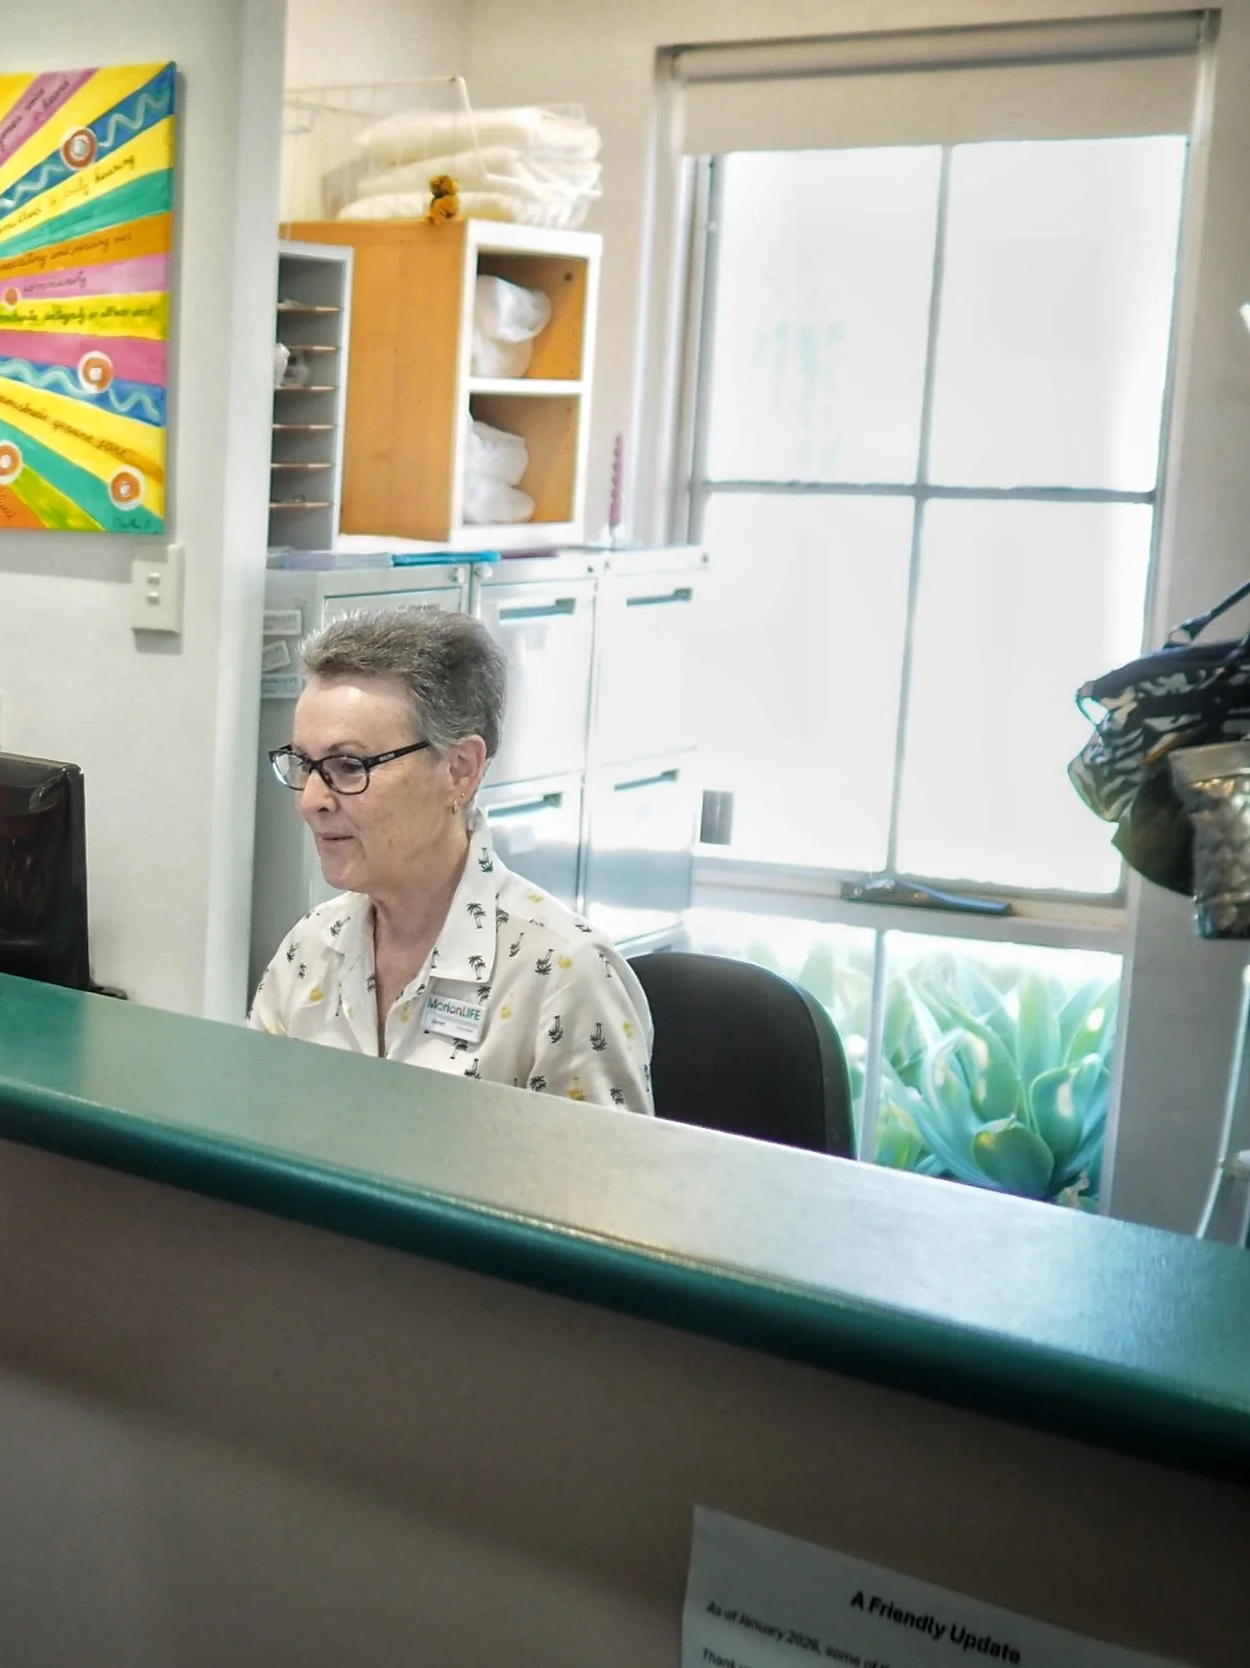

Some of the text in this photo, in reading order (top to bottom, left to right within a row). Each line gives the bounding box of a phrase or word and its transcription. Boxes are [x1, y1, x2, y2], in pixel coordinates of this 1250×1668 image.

[706, 1600, 723, 1617] As
[723, 1610, 739, 1623] of
[738, 1612, 785, 1643] January
[850, 1590, 1022, 1665] A Friendly Update
